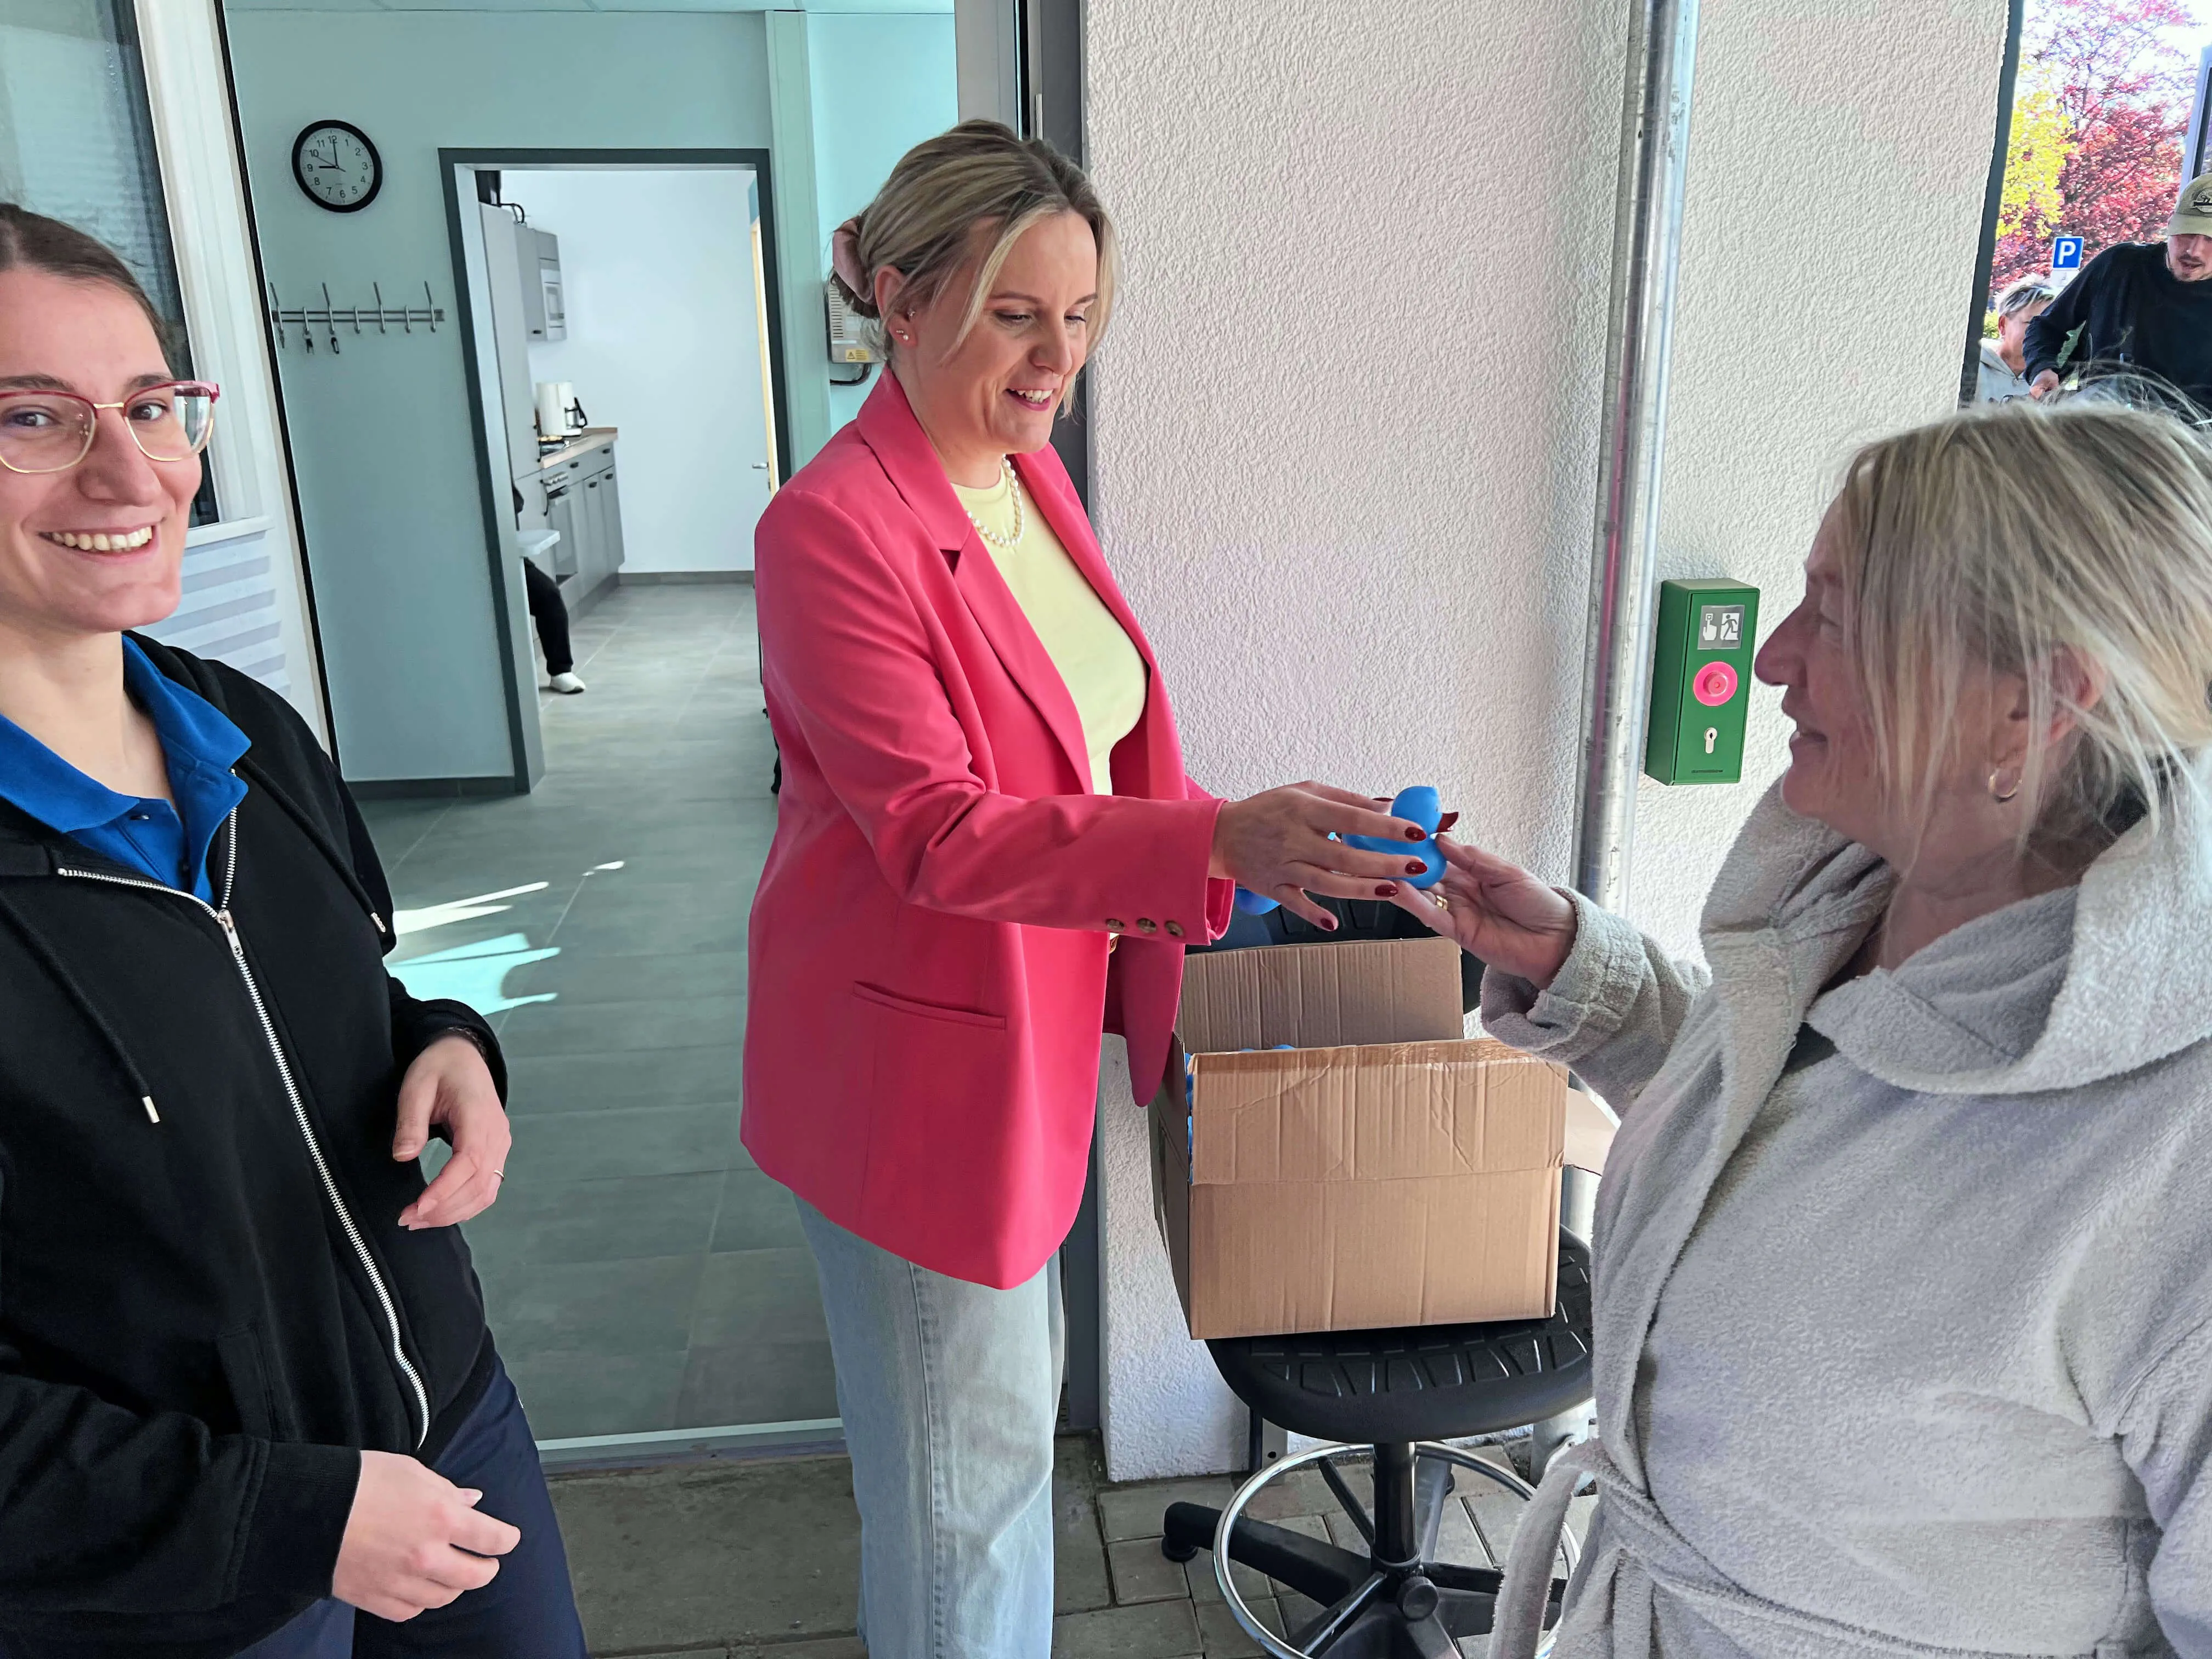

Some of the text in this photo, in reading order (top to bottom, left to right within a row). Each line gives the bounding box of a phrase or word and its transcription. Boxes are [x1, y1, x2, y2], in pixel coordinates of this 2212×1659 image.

[328, 135, 337, 144] 12
[309, 149, 319, 157] 10
[307, 163, 313, 172] 9
[314, 177, 320, 185] 8
[326, 187, 332, 195] 7
[351, 185, 358, 194] 5
[340, 190, 346, 199] 6
[2058, 241, 2076, 264] P
